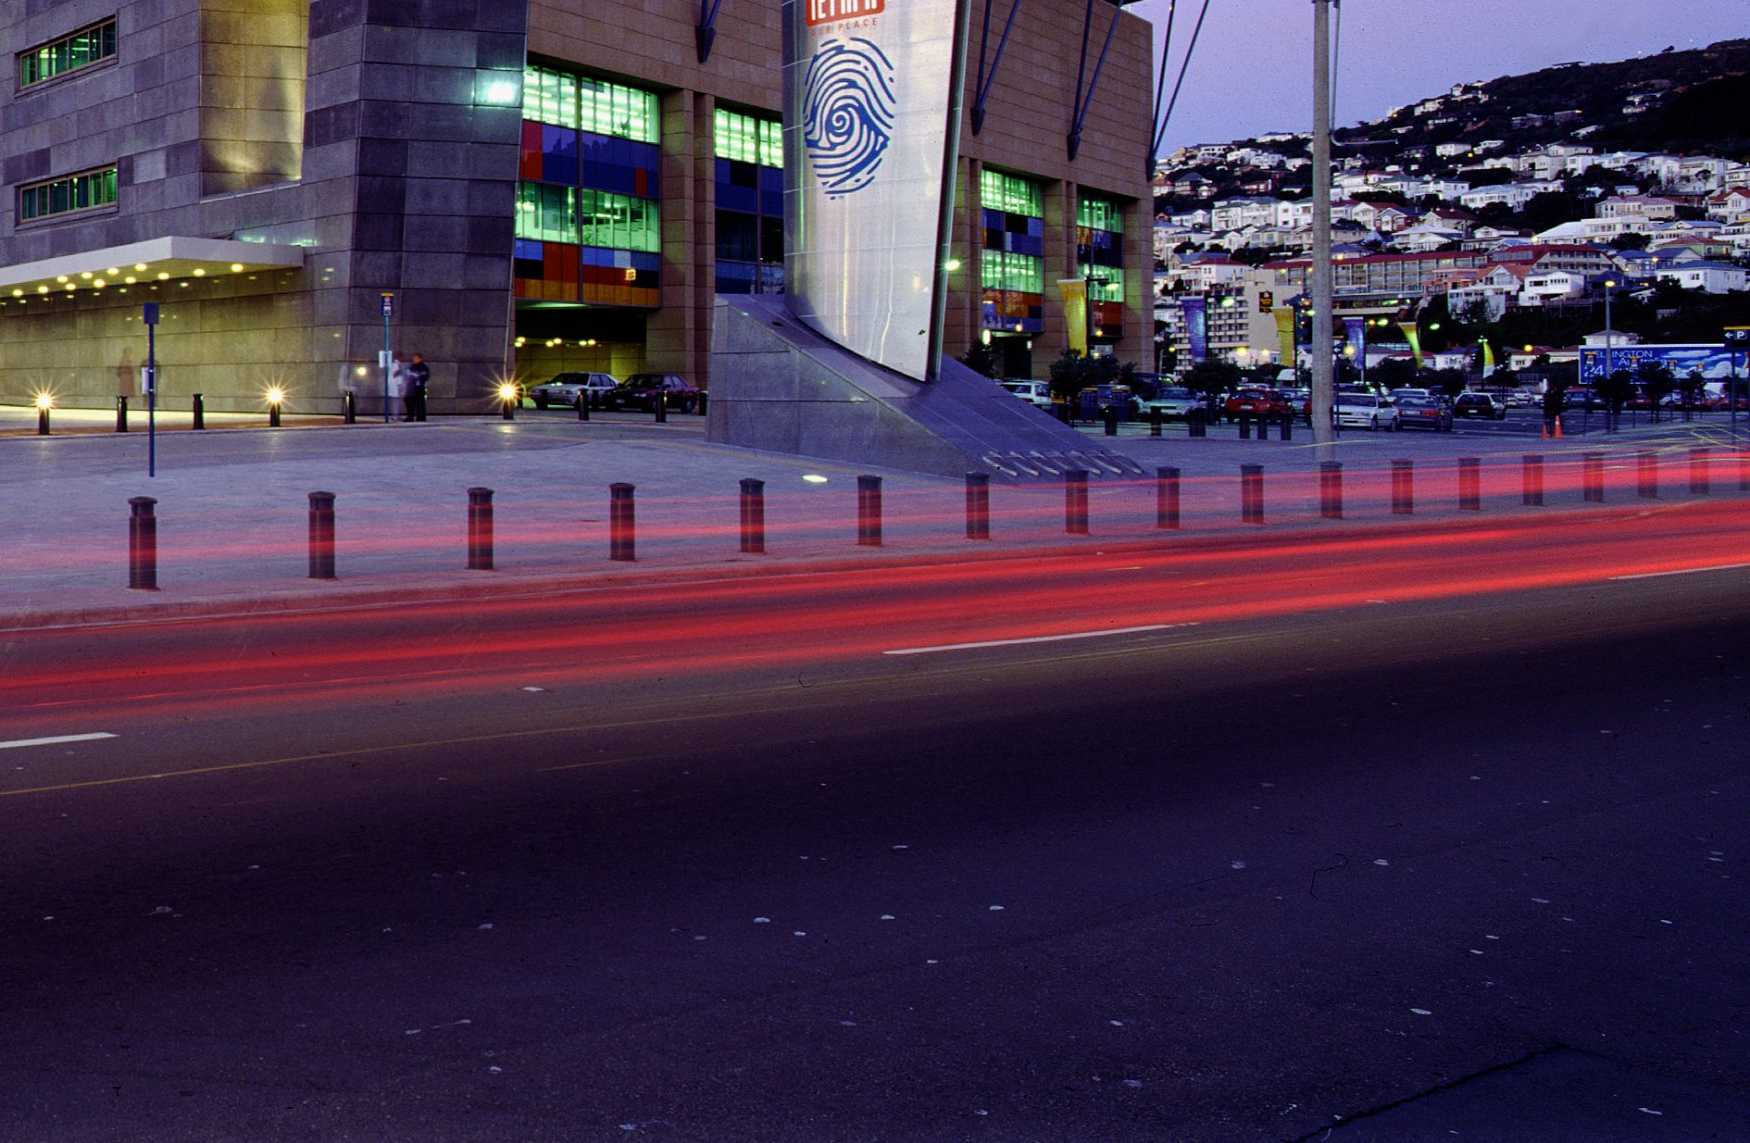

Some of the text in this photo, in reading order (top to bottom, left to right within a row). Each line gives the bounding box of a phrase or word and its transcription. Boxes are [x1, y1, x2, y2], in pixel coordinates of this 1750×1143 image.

[838, 17, 878, 31] PLACE
[1737, 331, 1745, 339] P
[1585, 350, 1653, 358] ELINGTON
